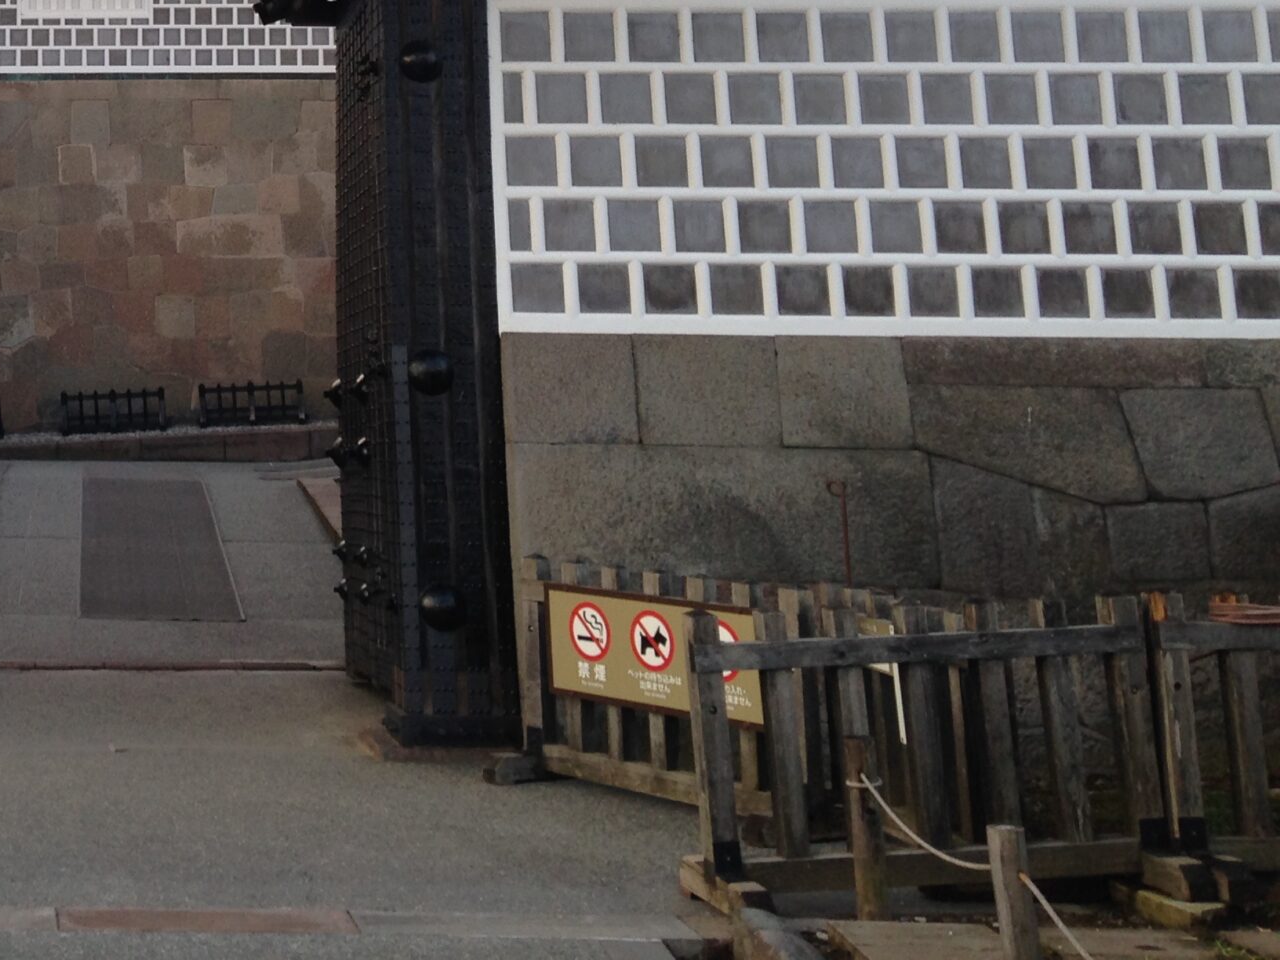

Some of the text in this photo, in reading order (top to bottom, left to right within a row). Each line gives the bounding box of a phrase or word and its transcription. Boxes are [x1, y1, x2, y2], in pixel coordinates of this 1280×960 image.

[578, 661, 606, 682] 禁煙
[627, 669, 682, 686] ペットの持ち込みは
